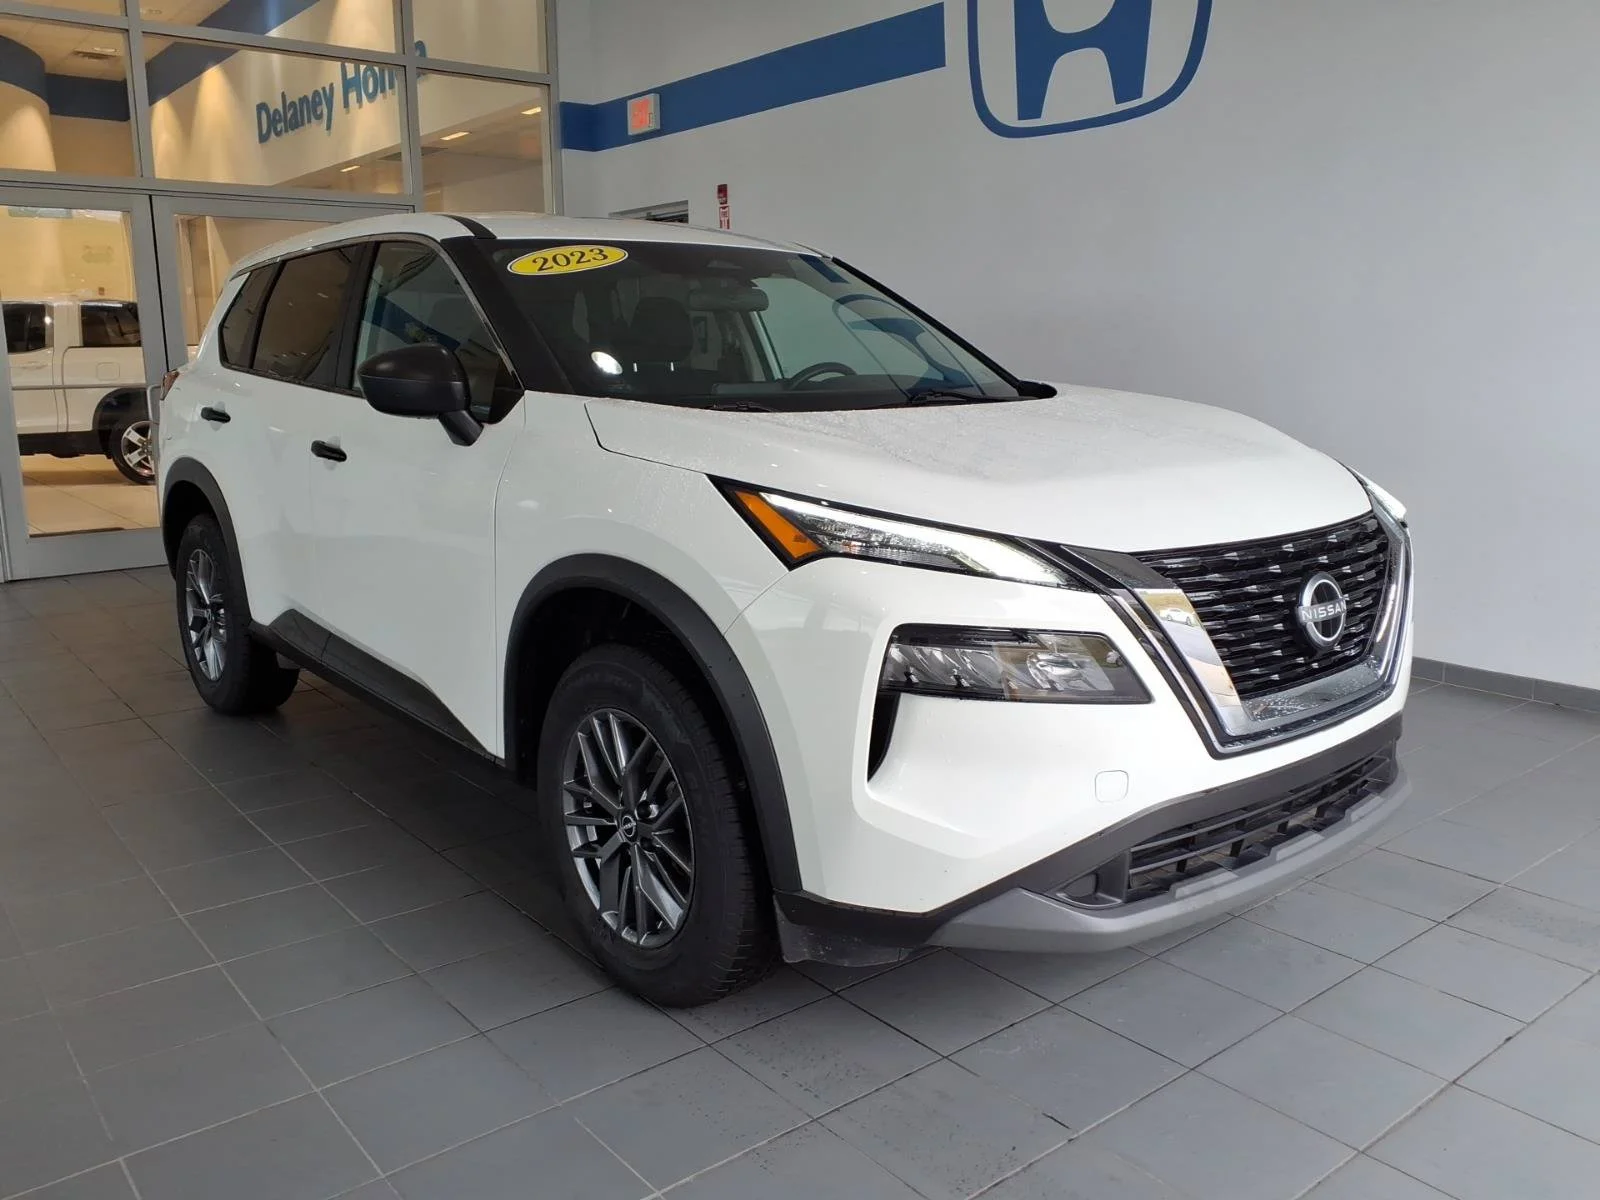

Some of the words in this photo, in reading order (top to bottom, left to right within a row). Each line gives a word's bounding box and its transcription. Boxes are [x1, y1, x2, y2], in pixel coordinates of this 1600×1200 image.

[256, 82, 335, 144] Delaney
[340, 41, 427, 109] Hona
[532, 247, 609, 272] 2023
[1301, 600, 1347, 621] NISSAN
